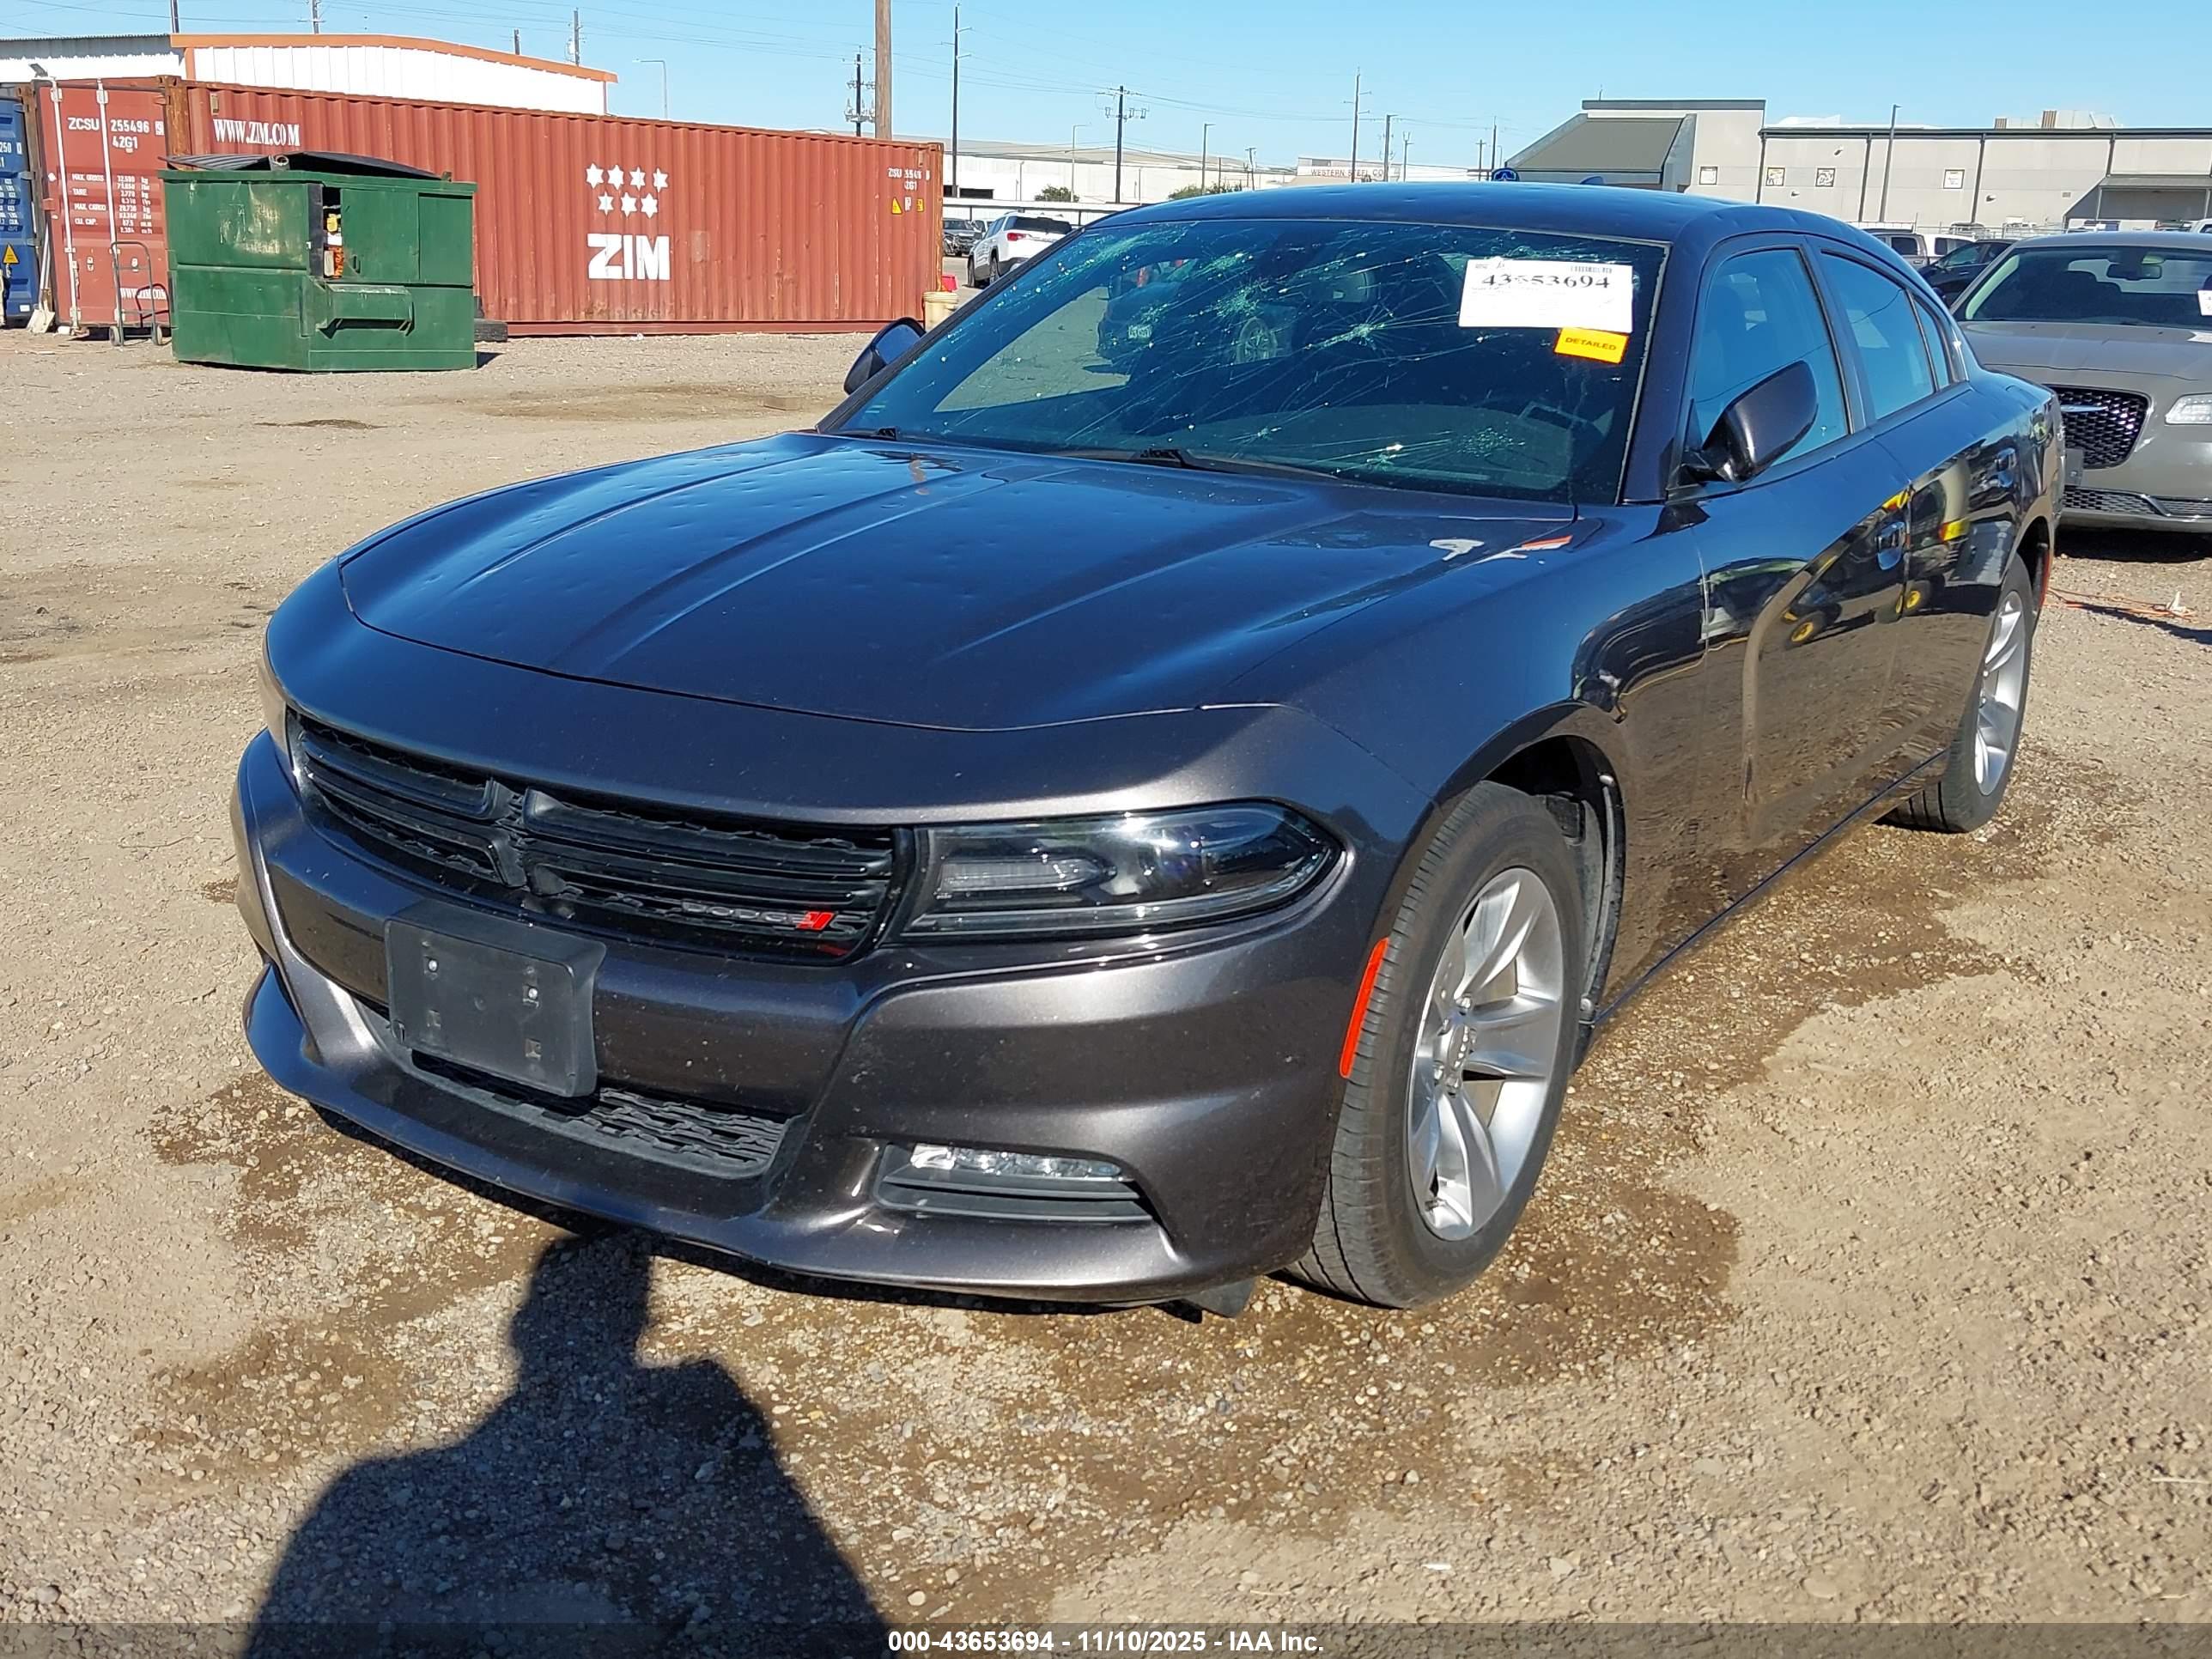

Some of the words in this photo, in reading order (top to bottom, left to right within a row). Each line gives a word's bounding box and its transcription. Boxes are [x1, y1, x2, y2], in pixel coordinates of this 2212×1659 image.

[67, 117, 100, 131] ZCSU
[110, 118, 150, 134] 255496
[112, 135, 138, 149] 42G1
[1310, 168, 1346, 177] WESTERN
[1347, 168, 1369, 177] SEEL
[586, 233, 671, 281] ZIM
[1565, 336, 1618, 352] DETAILED
[682, 901, 811, 926] DODGE
